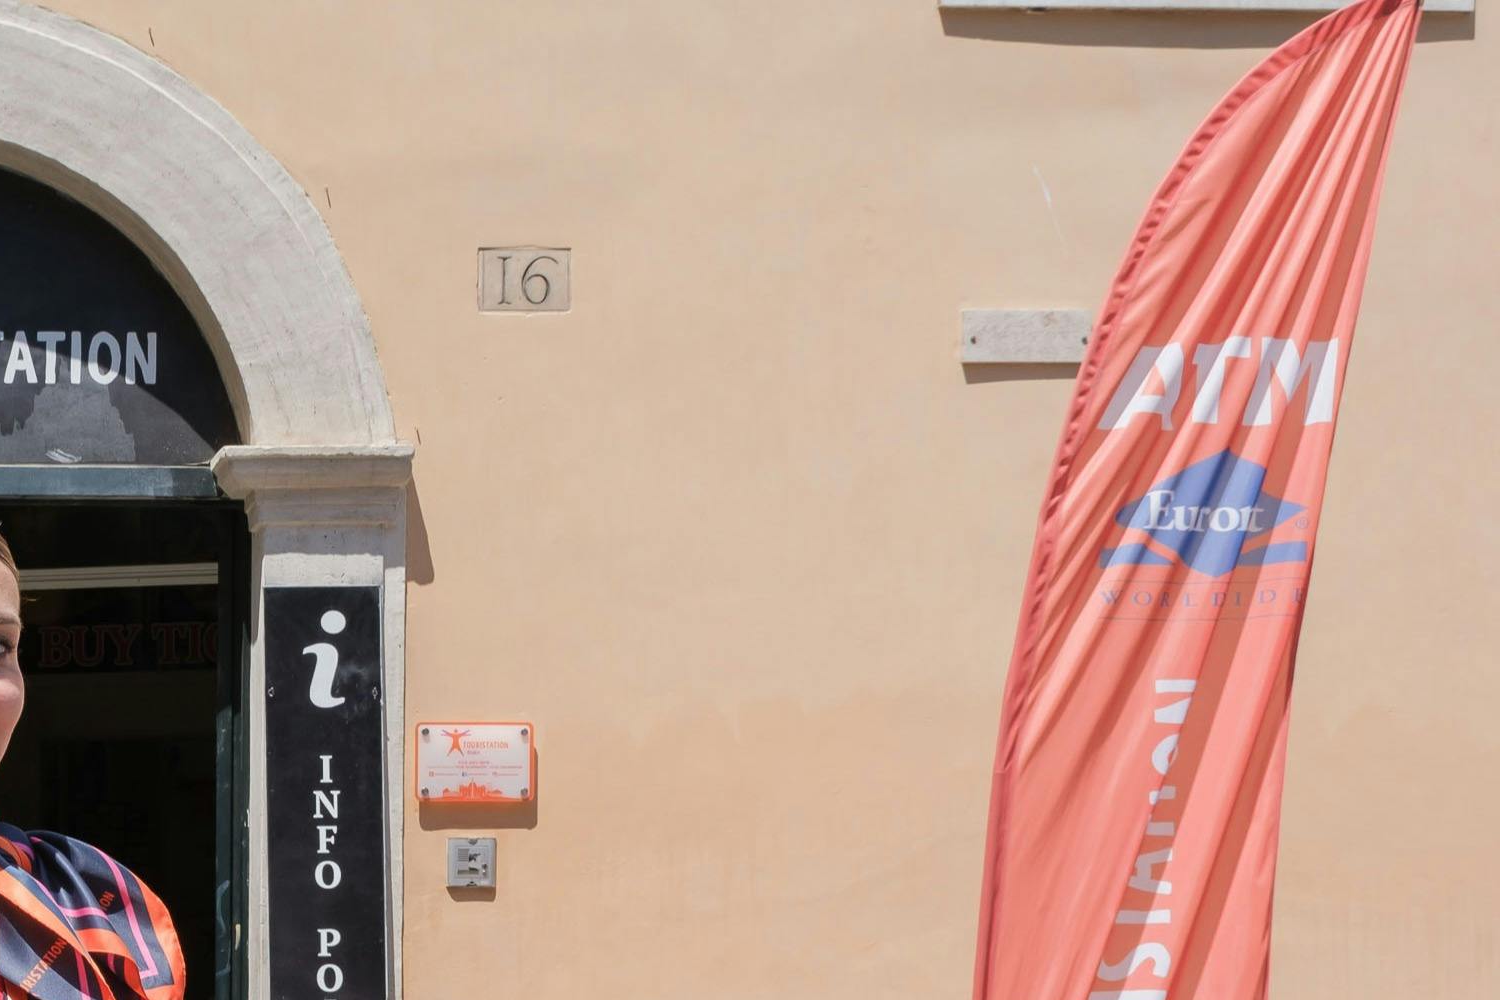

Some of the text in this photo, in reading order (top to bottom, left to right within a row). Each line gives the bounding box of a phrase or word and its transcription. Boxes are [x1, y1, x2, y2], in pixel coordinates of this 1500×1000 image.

[497, 256, 559, 305] 16
[1097, 336, 1339, 431] ATM
[38, 624, 143, 668] BUY
[312, 754, 342, 890] INFO
